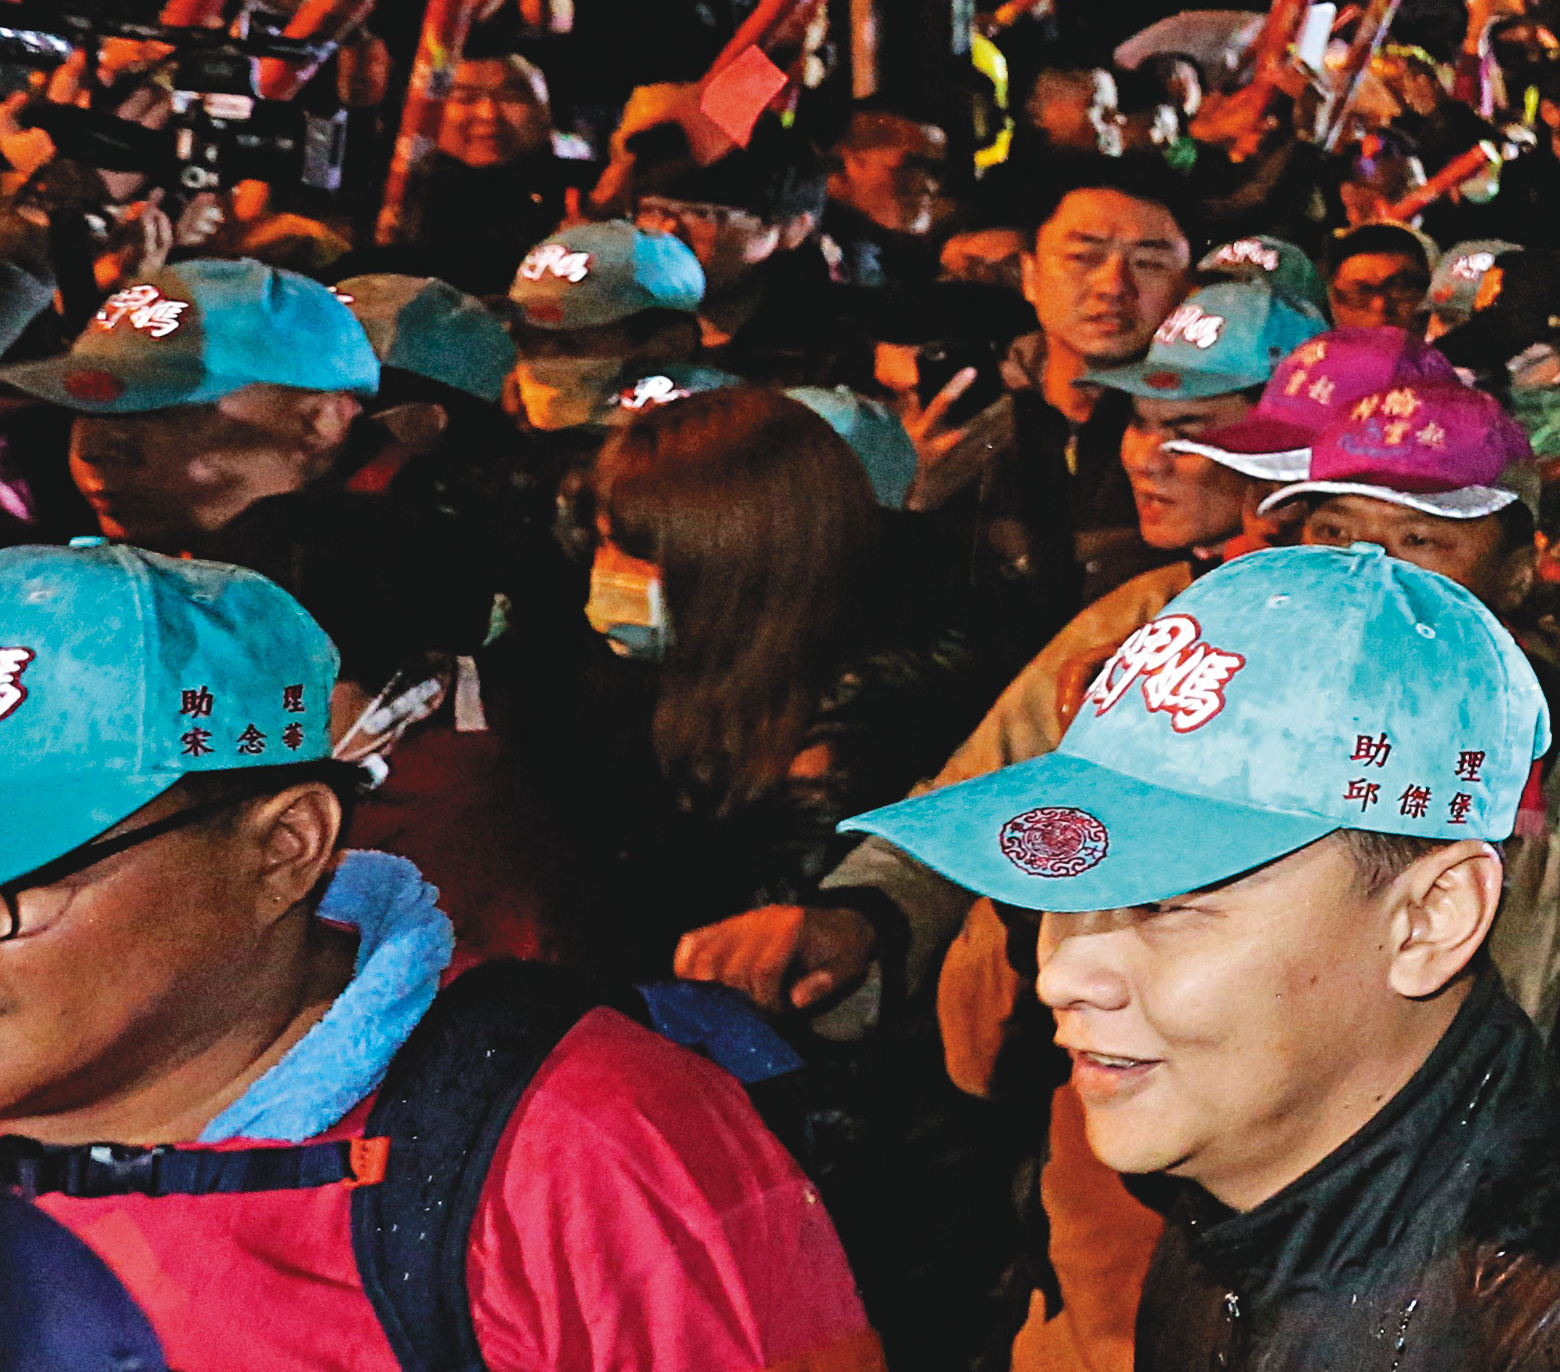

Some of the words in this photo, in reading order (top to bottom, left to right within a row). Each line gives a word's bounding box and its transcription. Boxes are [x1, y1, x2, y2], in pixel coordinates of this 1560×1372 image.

[178, 682, 306, 719] 助理
[180, 721, 304, 757] 宋念華
[1349, 731, 1486, 783] 助理
[1342, 777, 1473, 825] 邱傑堡
